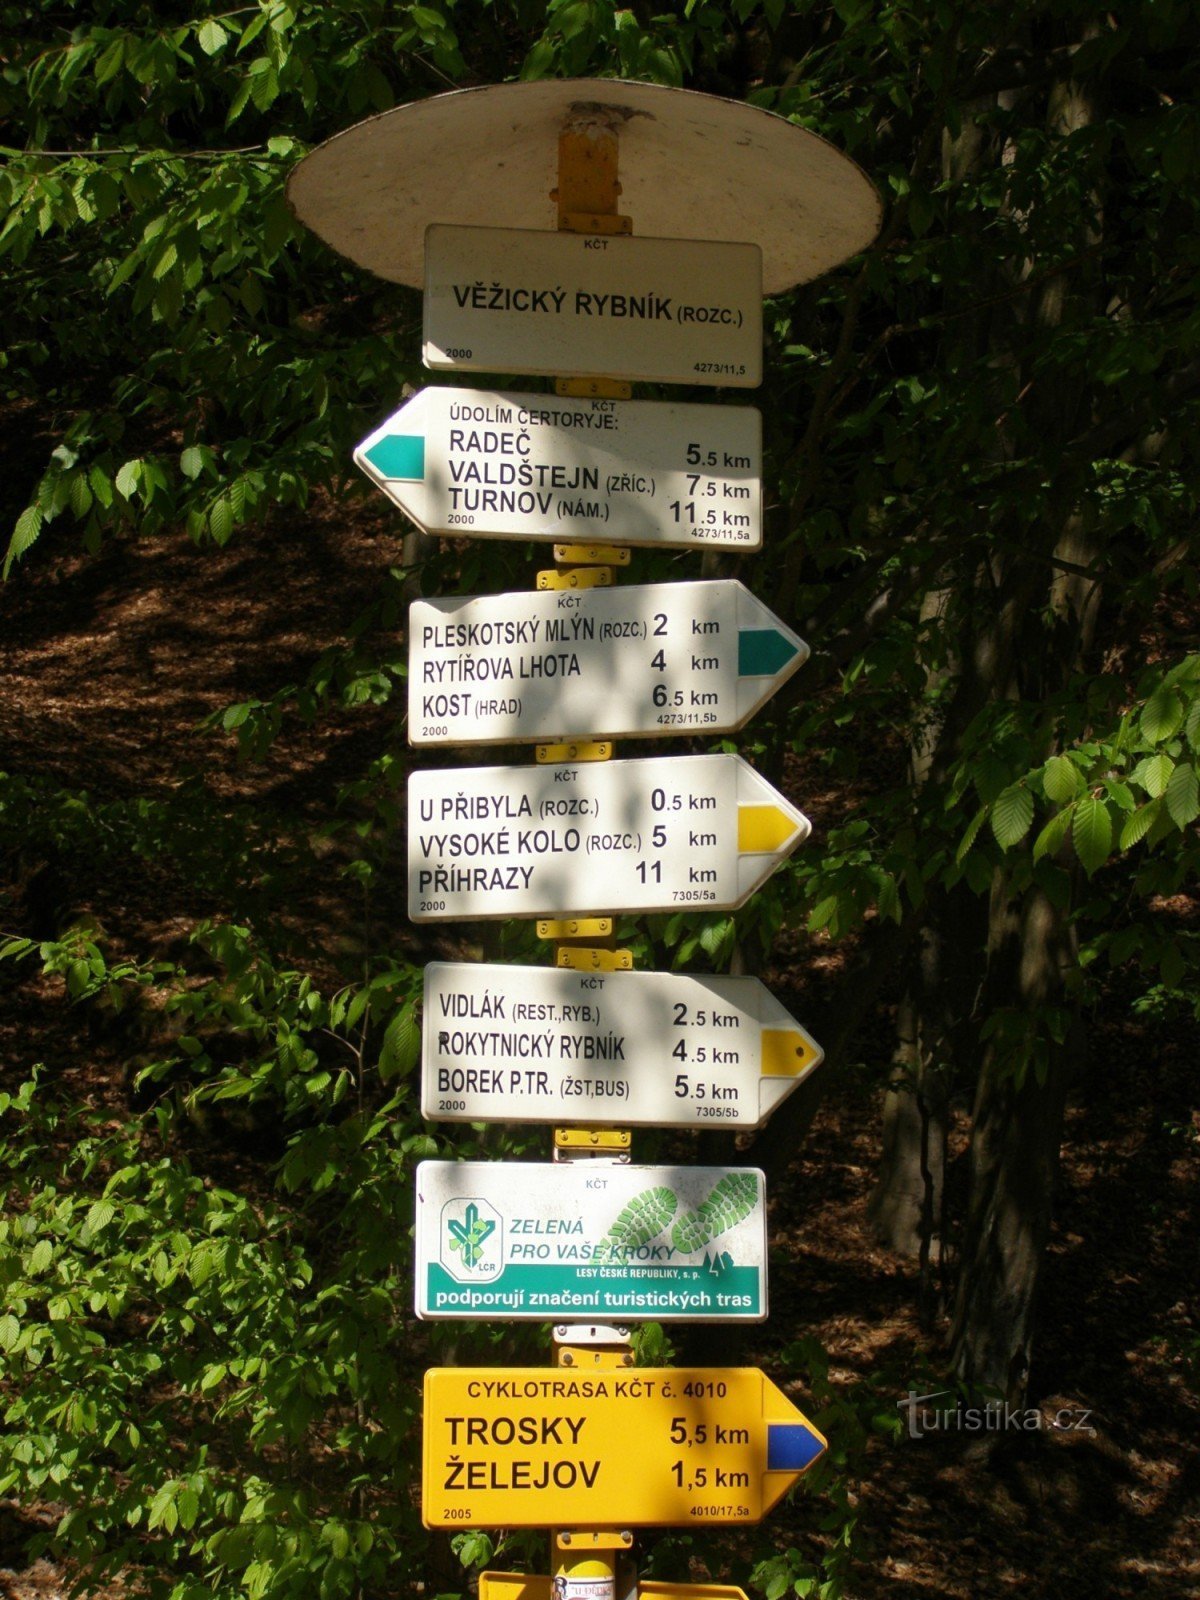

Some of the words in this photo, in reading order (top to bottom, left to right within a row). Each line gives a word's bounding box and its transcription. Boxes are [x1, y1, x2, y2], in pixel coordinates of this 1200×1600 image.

[584, 240, 608, 250] KČT
[453, 282, 567, 313] VĚŽICKÝ
[575, 292, 672, 320] RYBNÍK
[677, 305, 743, 328] (ROZC.)
[445, 348, 472, 359] 2000
[694, 363, 746, 375] 4273/11,5
[450, 402, 512, 424] ÚDOLÍM
[519, 406, 619, 430] ČERTORYJE:
[591, 401, 616, 412] KČT
[449, 429, 530, 455] RADEČ
[686, 444, 718, 466] 5.5
[724, 453, 751, 469] km
[449, 460, 599, 490] VALDŠTEJN
[606, 476, 656, 496] (ZŘÍC.)
[686, 475, 718, 497] 7.5
[723, 483, 751, 499] km
[449, 488, 553, 515] TURNOV
[556, 501, 610, 522] (NÁM.)
[669, 502, 718, 525] 11.5
[723, 511, 751, 527] km
[448, 515, 475, 524] 2000
[691, 528, 751, 540] 4273/11,5a
[558, 596, 581, 608] KČT
[423, 616, 540, 648] PLESKOTSKÝ
[545, 614, 595, 640] MLÝN
[599, 620, 647, 642] (ROZC.)
[653, 614, 668, 636] 2
[692, 619, 720, 635] km
[423, 652, 514, 683] RYTÍŘOVA
[519, 654, 581, 678] LHOTA
[651, 650, 666, 672] 4
[691, 656, 719, 671] km
[422, 694, 471, 717] KOST
[475, 698, 522, 718] (HRAD)
[652, 684, 684, 707] 6.5
[690, 691, 719, 706] km
[657, 712, 717, 725] 4273/11,5b
[422, 726, 448, 736] 2000
[555, 771, 578, 782] KČT
[420, 799, 433, 821] U
[441, 792, 532, 820] PŘIBYLA
[539, 798, 600, 820] (ROZC.)
[651, 789, 682, 811] 0.5
[689, 794, 717, 809] km
[420, 827, 509, 858] VYSOKÉ
[518, 829, 580, 854] KOLO
[586, 833, 642, 854] (ROZC.)
[652, 825, 666, 847] 5
[689, 831, 717, 846] km
[419, 864, 535, 893] PŘÍHRAZY
[635, 861, 662, 884] 11
[689, 867, 717, 883] km
[672, 890, 716, 902] 7305/5a
[420, 901, 446, 911] 2000
[581, 978, 605, 990] KČT
[440, 990, 506, 1019] VIDLÁK
[673, 1004, 706, 1026] 2.5
[712, 1011, 739, 1027] km
[438, 1029, 554, 1058] ROKYTNICKÝ
[560, 1035, 625, 1060] RYBNÍK
[673, 1039, 706, 1063] 4.5
[712, 1048, 739, 1063] km
[438, 1069, 504, 1093] BOREK
[510, 1071, 553, 1095] P.TR.
[560, 1078, 630, 1100] (ŽST,BUS)
[674, 1075, 706, 1099] 5.5
[712, 1084, 739, 1099] km
[439, 1100, 466, 1111] 2000
[696, 1107, 739, 1118] 7305/5b
[586, 1178, 608, 1189] KČT
[510, 1215, 584, 1234] ZELENÁ
[510, 1245, 551, 1259] PRO
[557, 1241, 604, 1260] VAŠE
[609, 1246, 677, 1260] KROKY
[576, 1267, 598, 1277] LESY
[600, 1266, 628, 1278] ČESKÉ
[630, 1268, 681, 1279] REPUBLIKY,
[683, 1271, 692, 1279] s.
[693, 1271, 700, 1281] p.
[436, 1289, 525, 1308] podporují
[529, 1289, 599, 1306] značení
[604, 1290, 713, 1307] turistických
[717, 1294, 752, 1307] tras
[467, 1381, 607, 1398] CYKLOTRASA
[615, 1378, 655, 1398] KČT
[662, 1381, 677, 1398] č.
[683, 1382, 727, 1398] 4010
[445, 1417, 586, 1446] TROSKY
[670, 1417, 707, 1448] 5,5
[715, 1424, 749, 1444] km
[444, 1455, 601, 1490] ŽELEJOV
[671, 1461, 707, 1492] 1,5
[715, 1467, 749, 1488] km
[443, 1509, 472, 1520] 2005
[690, 1505, 750, 1517] 4010/17,5a
